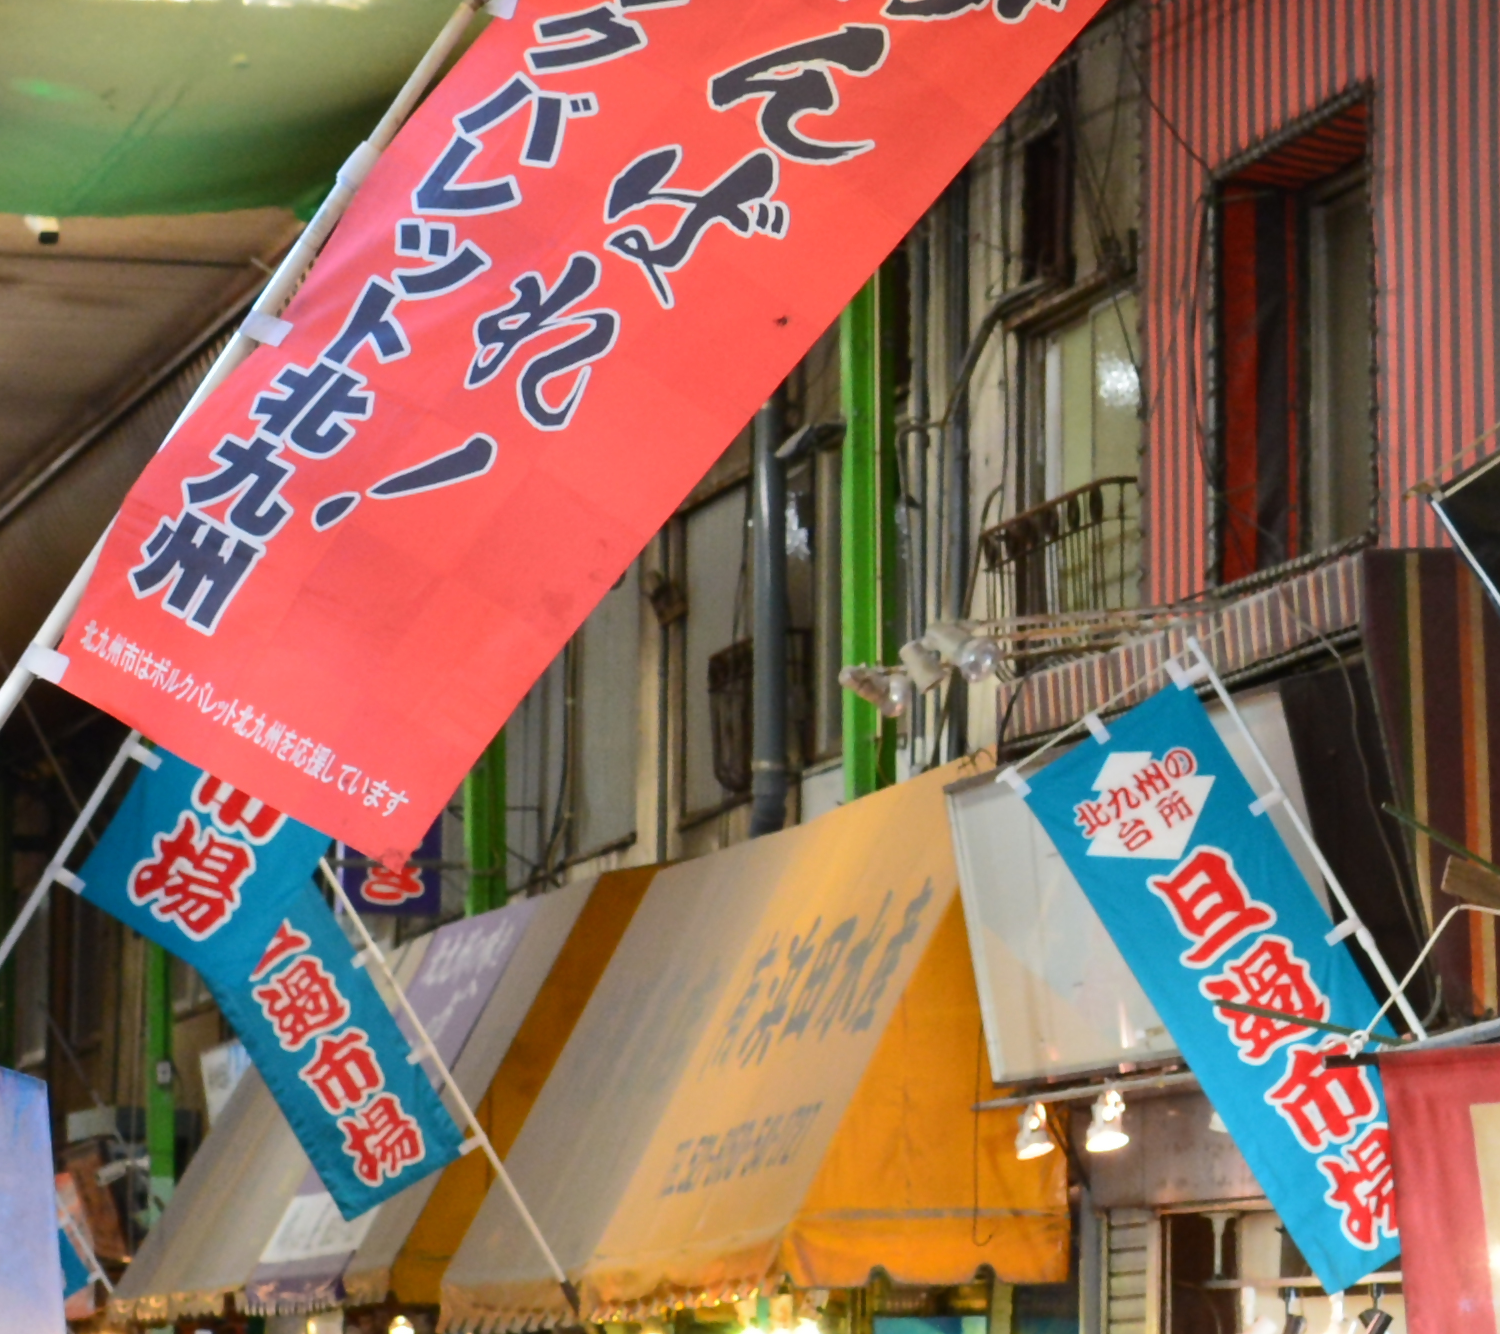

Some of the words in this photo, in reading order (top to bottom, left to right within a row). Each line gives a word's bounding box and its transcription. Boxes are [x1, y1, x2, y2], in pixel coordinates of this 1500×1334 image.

[79, 618, 410, 818] 北九州市はボルクバレット北九州を応援しています
[1072, 745, 1198, 840] 北九州の
[1146, 849, 1399, 1251] 旦過市場
